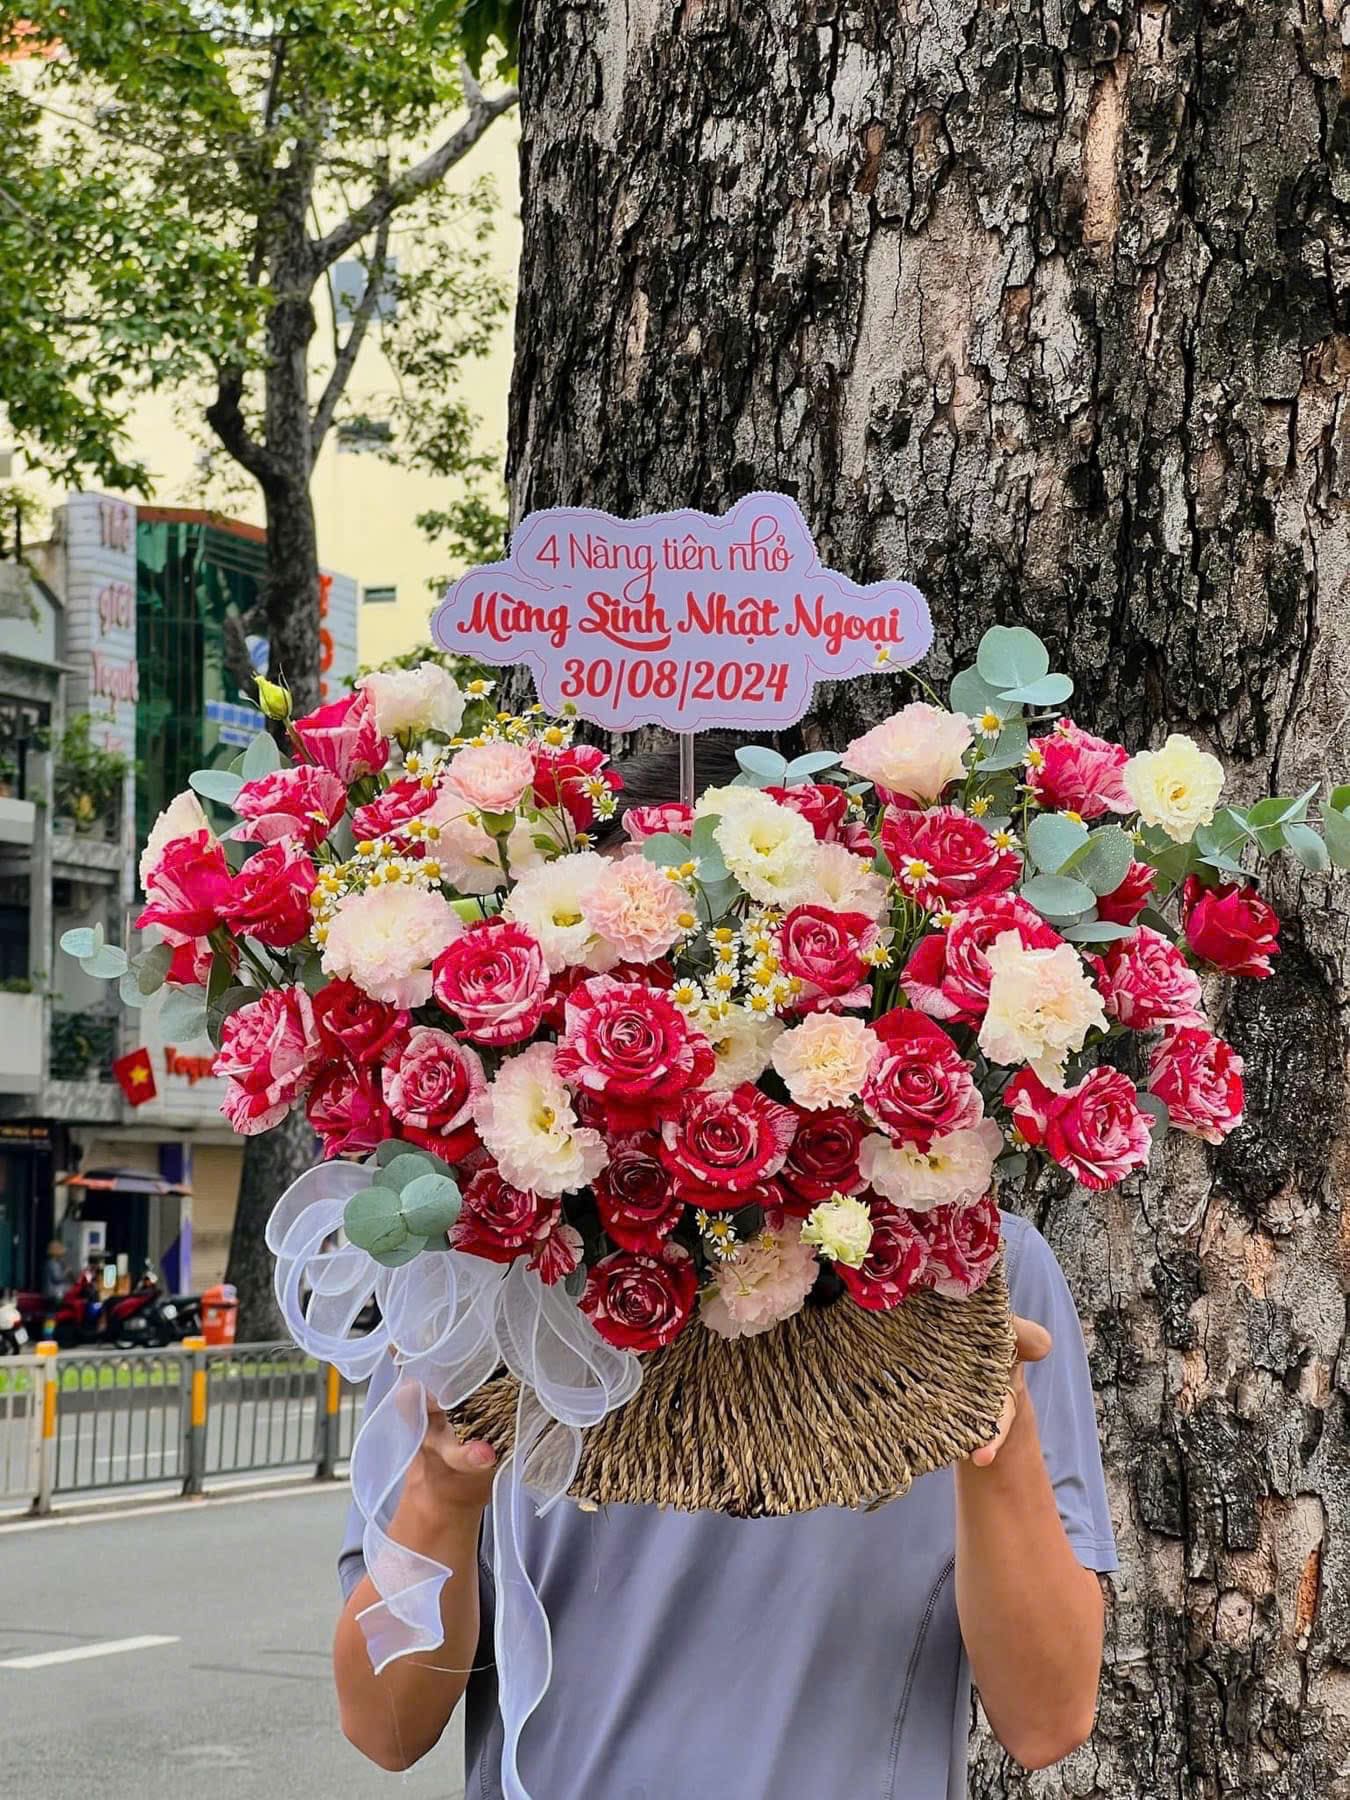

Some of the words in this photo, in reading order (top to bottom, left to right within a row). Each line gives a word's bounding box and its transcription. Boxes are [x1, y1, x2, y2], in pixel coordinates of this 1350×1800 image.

[536, 535, 561, 570] 4
[569, 533, 658, 604] Nàng
[662, 534, 722, 572] tiên
[728, 515, 794, 572] nhỏ
[457, 591, 571, 649] Mừng
[578, 591, 673, 653] Sinh
[677, 591, 780, 646] Nhật
[785, 593, 904, 654] Ngoại
[560, 658, 790, 712] 30/08/2024
